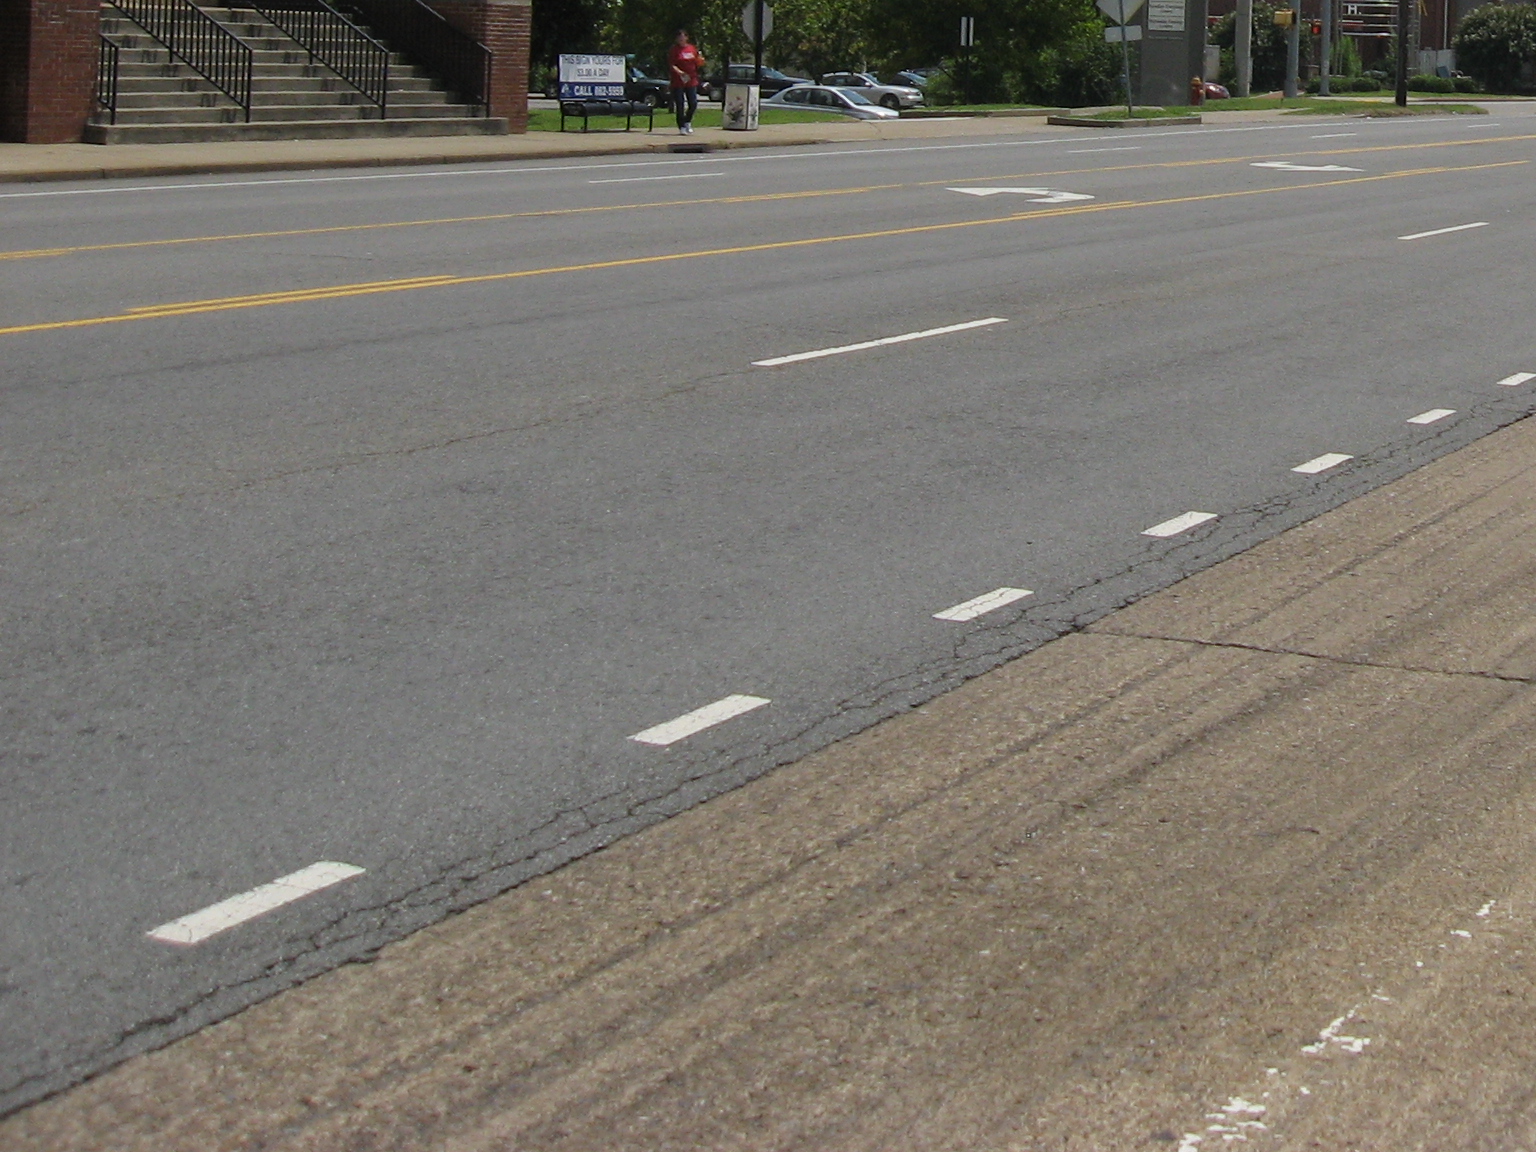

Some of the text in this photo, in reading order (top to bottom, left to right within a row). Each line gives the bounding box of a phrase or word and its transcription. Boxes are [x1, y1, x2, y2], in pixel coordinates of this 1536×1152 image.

[592, 55, 612, 65] YOURS
[612, 56, 624, 65] FOR
[574, 85, 593, 96] CALL
